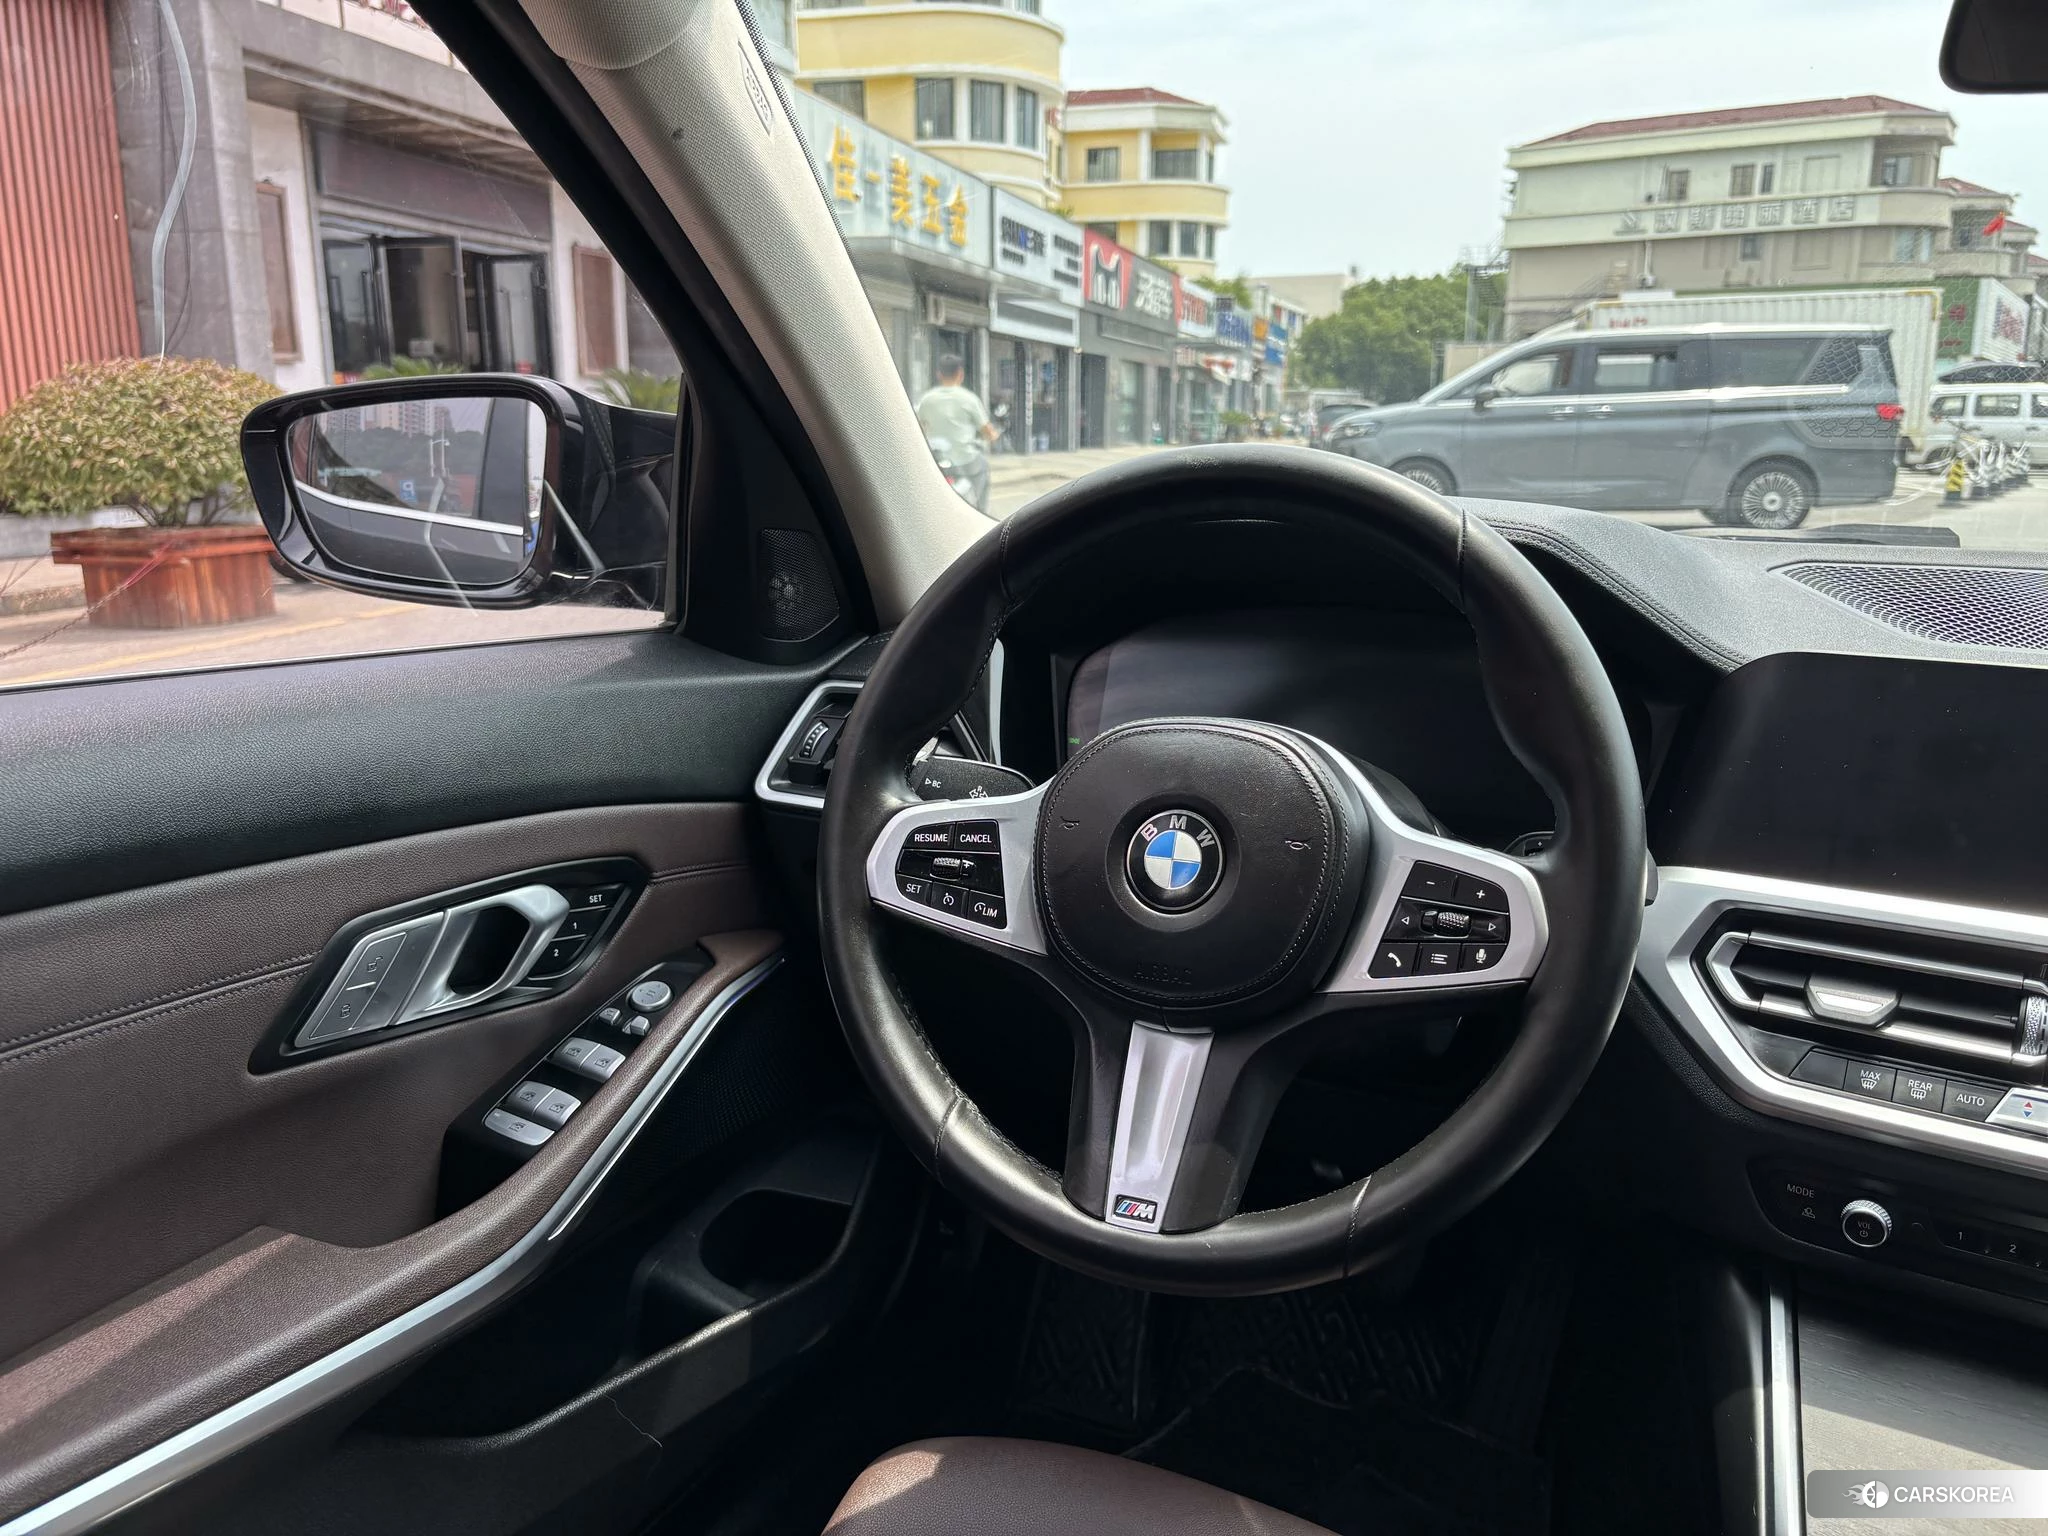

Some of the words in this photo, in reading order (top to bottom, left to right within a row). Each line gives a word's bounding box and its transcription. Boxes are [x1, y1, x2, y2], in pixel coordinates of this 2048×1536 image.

[931, 780, 942, 788] BC
[1140, 815, 1215, 848] BMW
[914, 833, 948, 842] RESUME
[960, 834, 992, 843] CANCEL
[905, 883, 922, 894] SET
[589, 894, 603, 904] SET
[982, 908, 998, 918] LIM
[553, 948, 559, 957] 2
[1860, 1069, 1881, 1081] MAX
[1908, 1079, 1933, 1092] REAR
[1956, 1093, 1985, 1107] AUTO
[1786, 1183, 1816, 1199] MODE
[1857, 1220, 1872, 1231] VOL
[2008, 1244, 2017, 1254] 2
